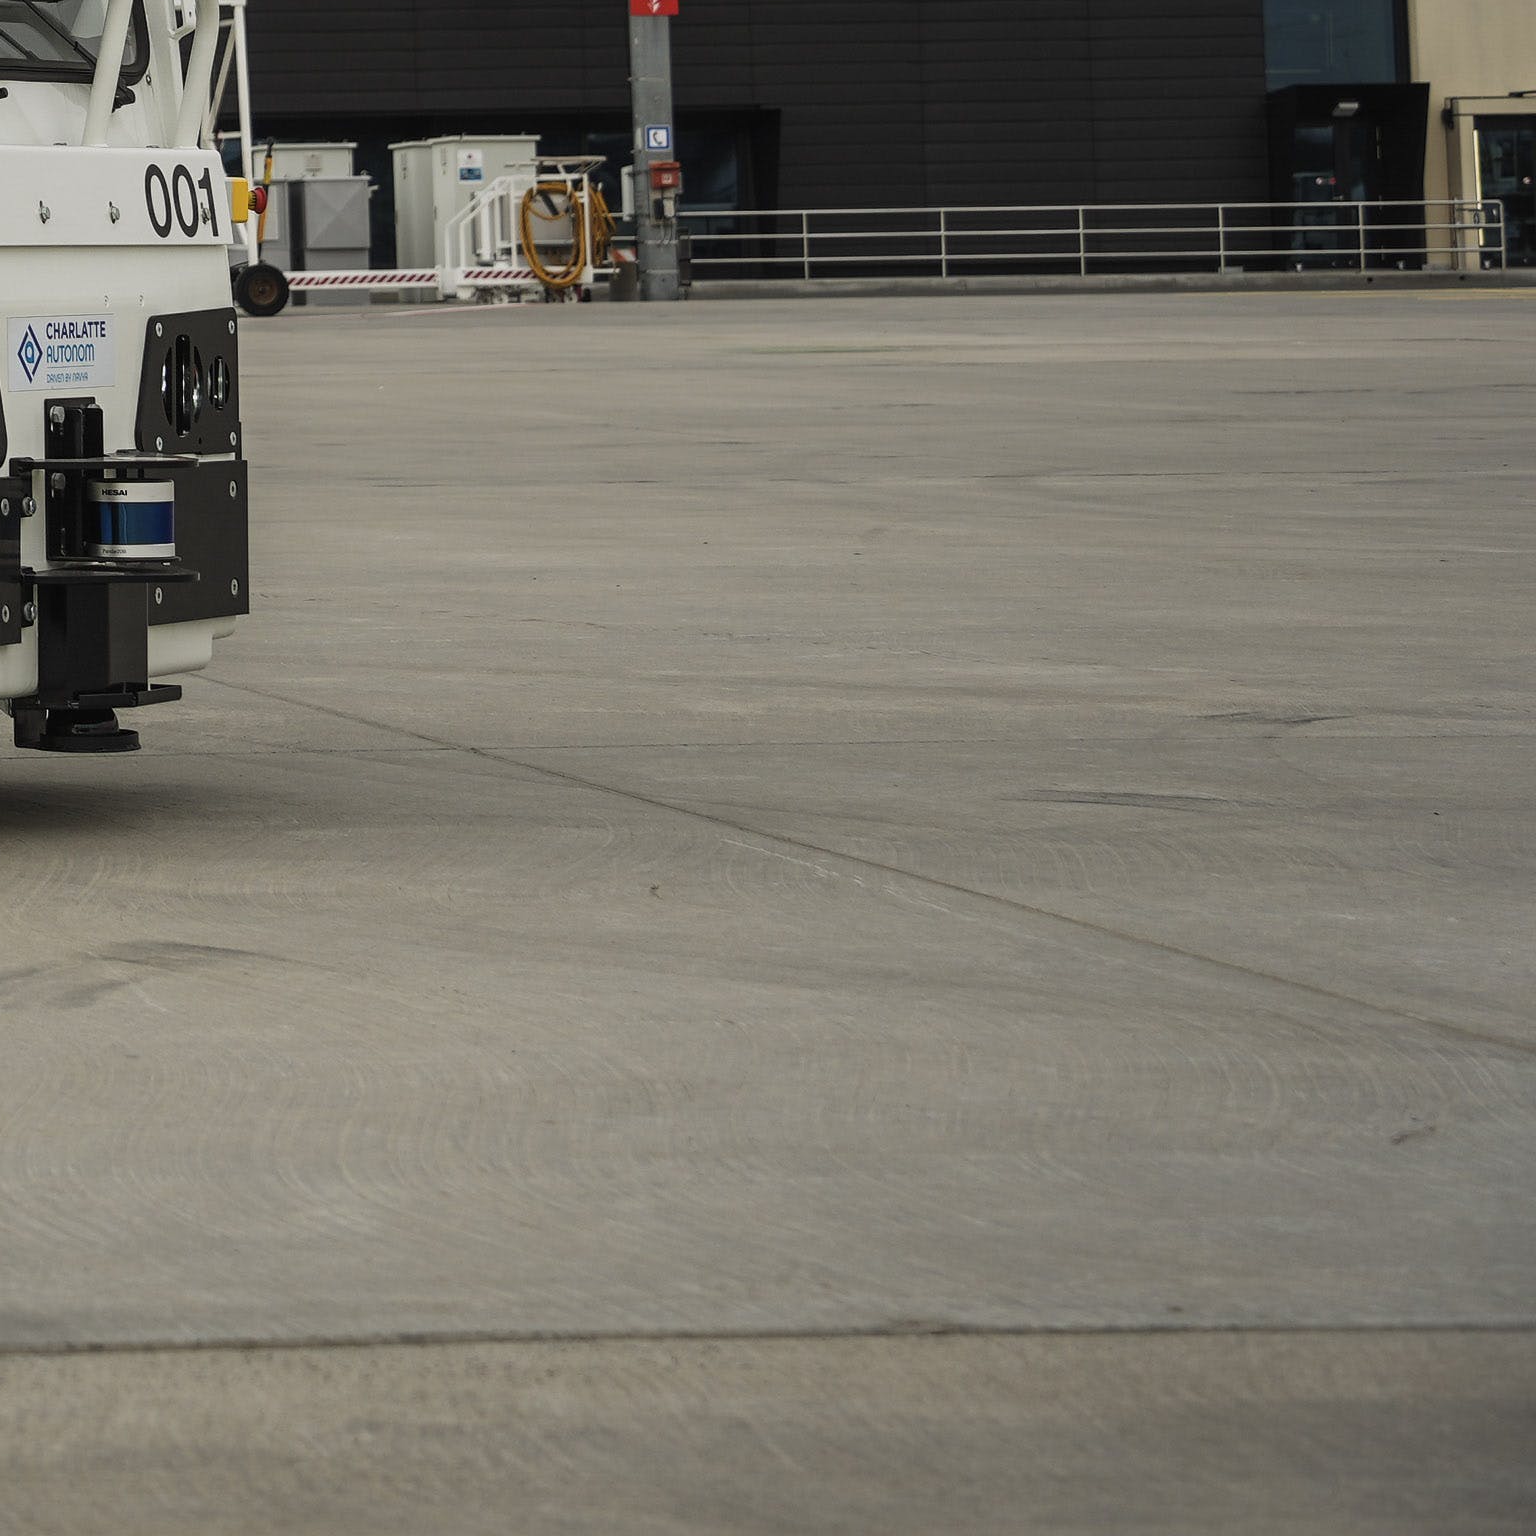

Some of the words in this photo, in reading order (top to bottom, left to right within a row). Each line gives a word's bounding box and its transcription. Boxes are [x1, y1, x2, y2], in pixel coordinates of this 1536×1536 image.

[144, 163, 219, 239] 001
[45, 320, 106, 340] CHARLATTE
[46, 343, 95, 363] AUTONOM
